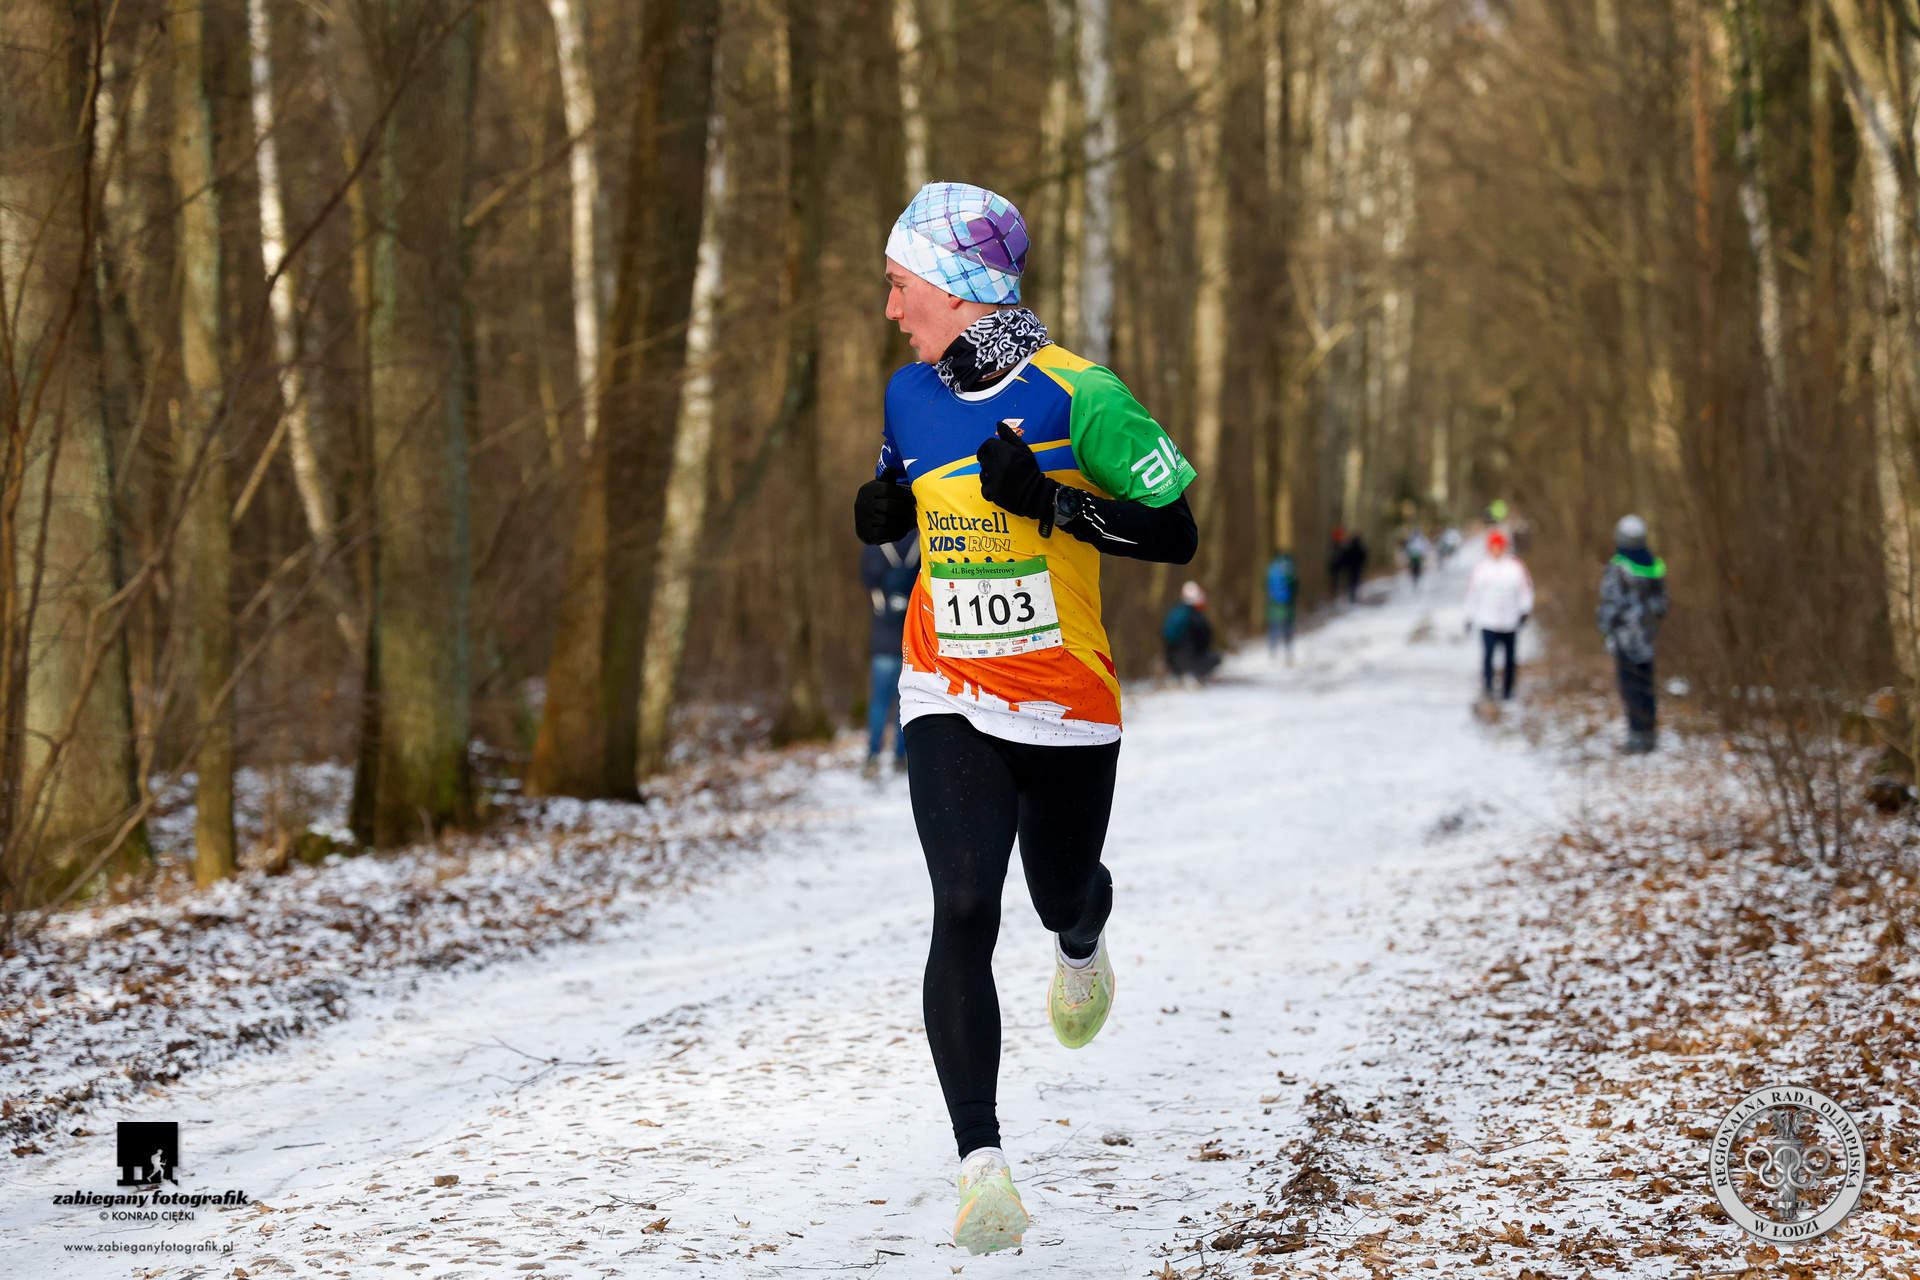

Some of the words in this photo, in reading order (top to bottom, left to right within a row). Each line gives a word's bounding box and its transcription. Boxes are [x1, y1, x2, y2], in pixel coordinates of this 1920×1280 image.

[926, 511, 1010, 534] Naturell
[929, 535, 966, 552] KIDS
[968, 535, 1011, 553] RUN
[951, 567, 960, 575] 41.
[961, 567, 975, 576] Bieg
[976, 566, 1016, 577] Sylwestrowy
[947, 591, 1036, 626] 1103
